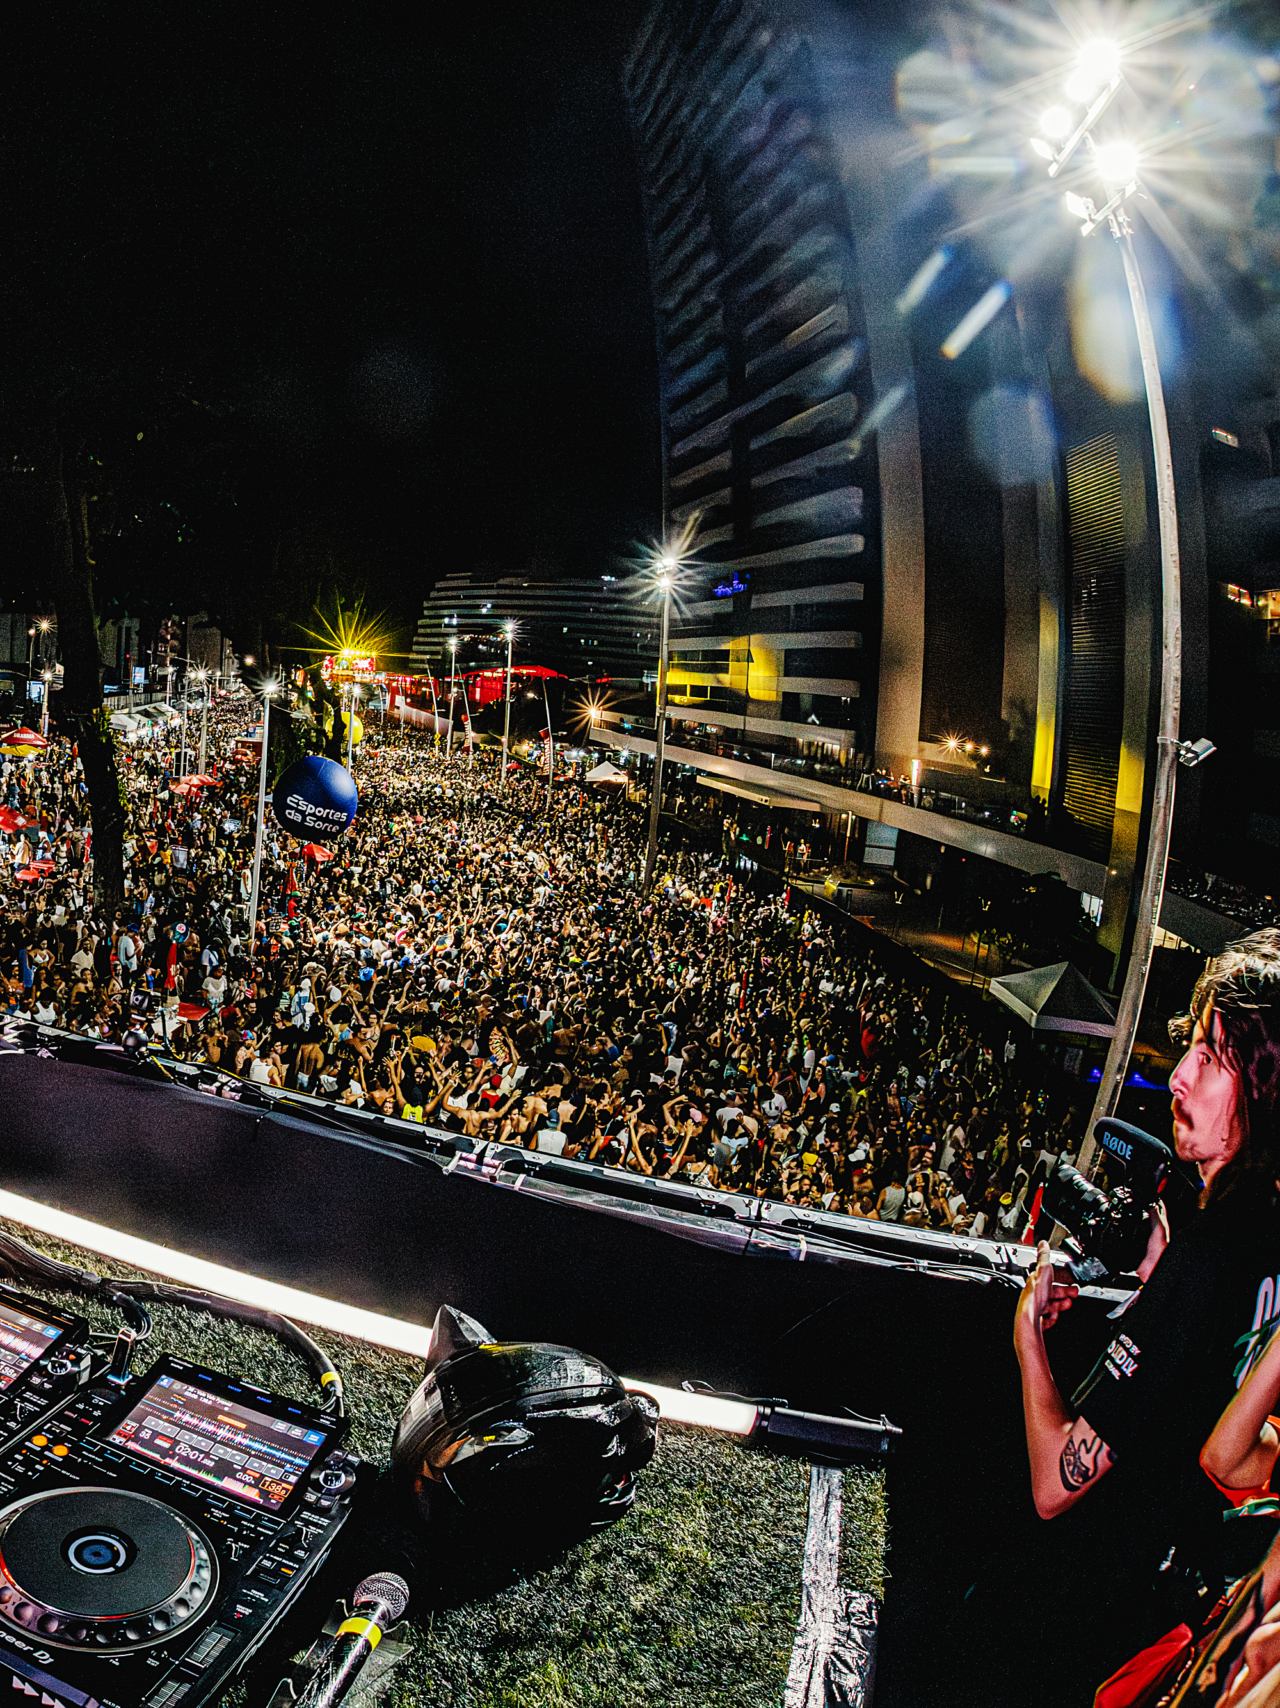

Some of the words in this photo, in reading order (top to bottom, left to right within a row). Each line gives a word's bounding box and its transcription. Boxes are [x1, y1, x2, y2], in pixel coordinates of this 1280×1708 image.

[286, 794, 348, 822] Esportes
[285, 810, 303, 823] da
[303, 816, 340, 833] Sorte
[1102, 1131, 1134, 1161] RØDE
[33, 1649, 55, 1665] DJ
